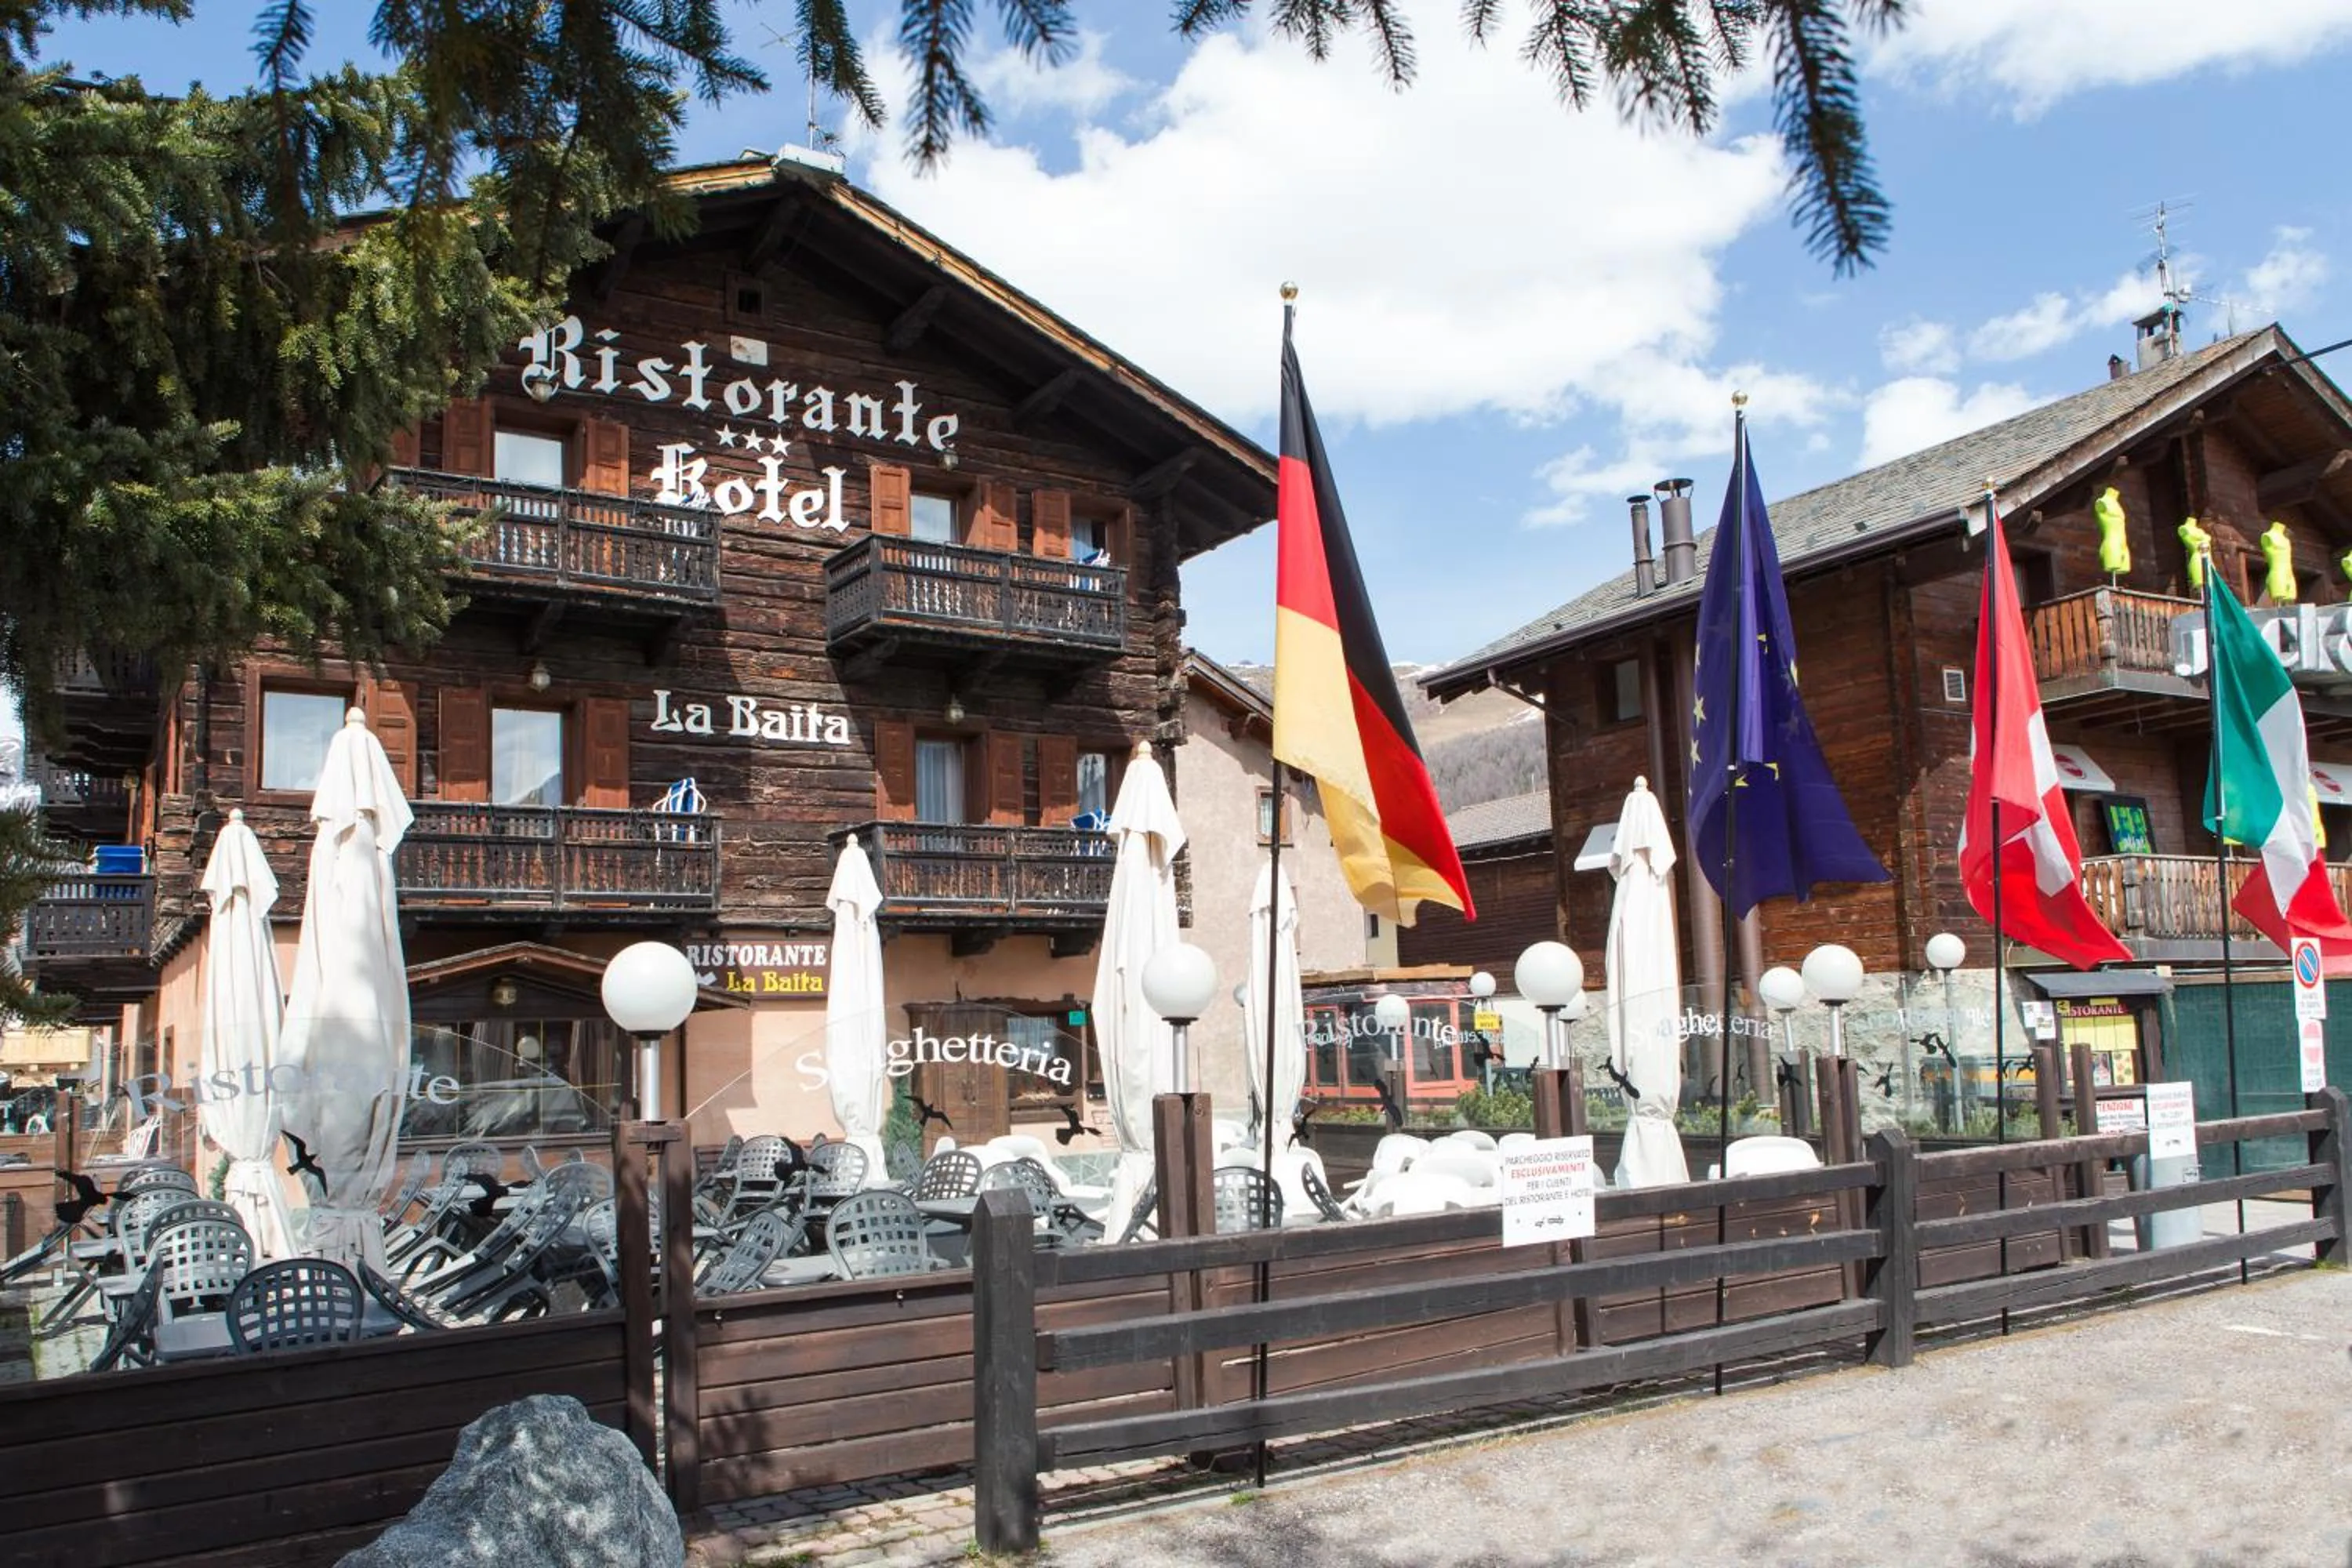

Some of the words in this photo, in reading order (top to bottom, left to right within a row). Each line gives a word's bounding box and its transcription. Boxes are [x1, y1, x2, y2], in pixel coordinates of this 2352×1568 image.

[519, 315, 959, 451] Ristorante
[650, 441, 850, 534] Hotel
[650, 689, 714, 734] La
[726, 695, 851, 744] Baita
[686, 944, 826, 967] RISTORANTE
[727, 971, 757, 993] La
[761, 971, 824, 993] Baita
[2068, 1004, 2124, 1017] STORANTE
[795, 1027, 1072, 1092] Sghetteria
[1511, 1162, 1585, 1179] ESCLUSIVAMENTE
[1519, 1190, 1563, 1204] RISTORANTE
